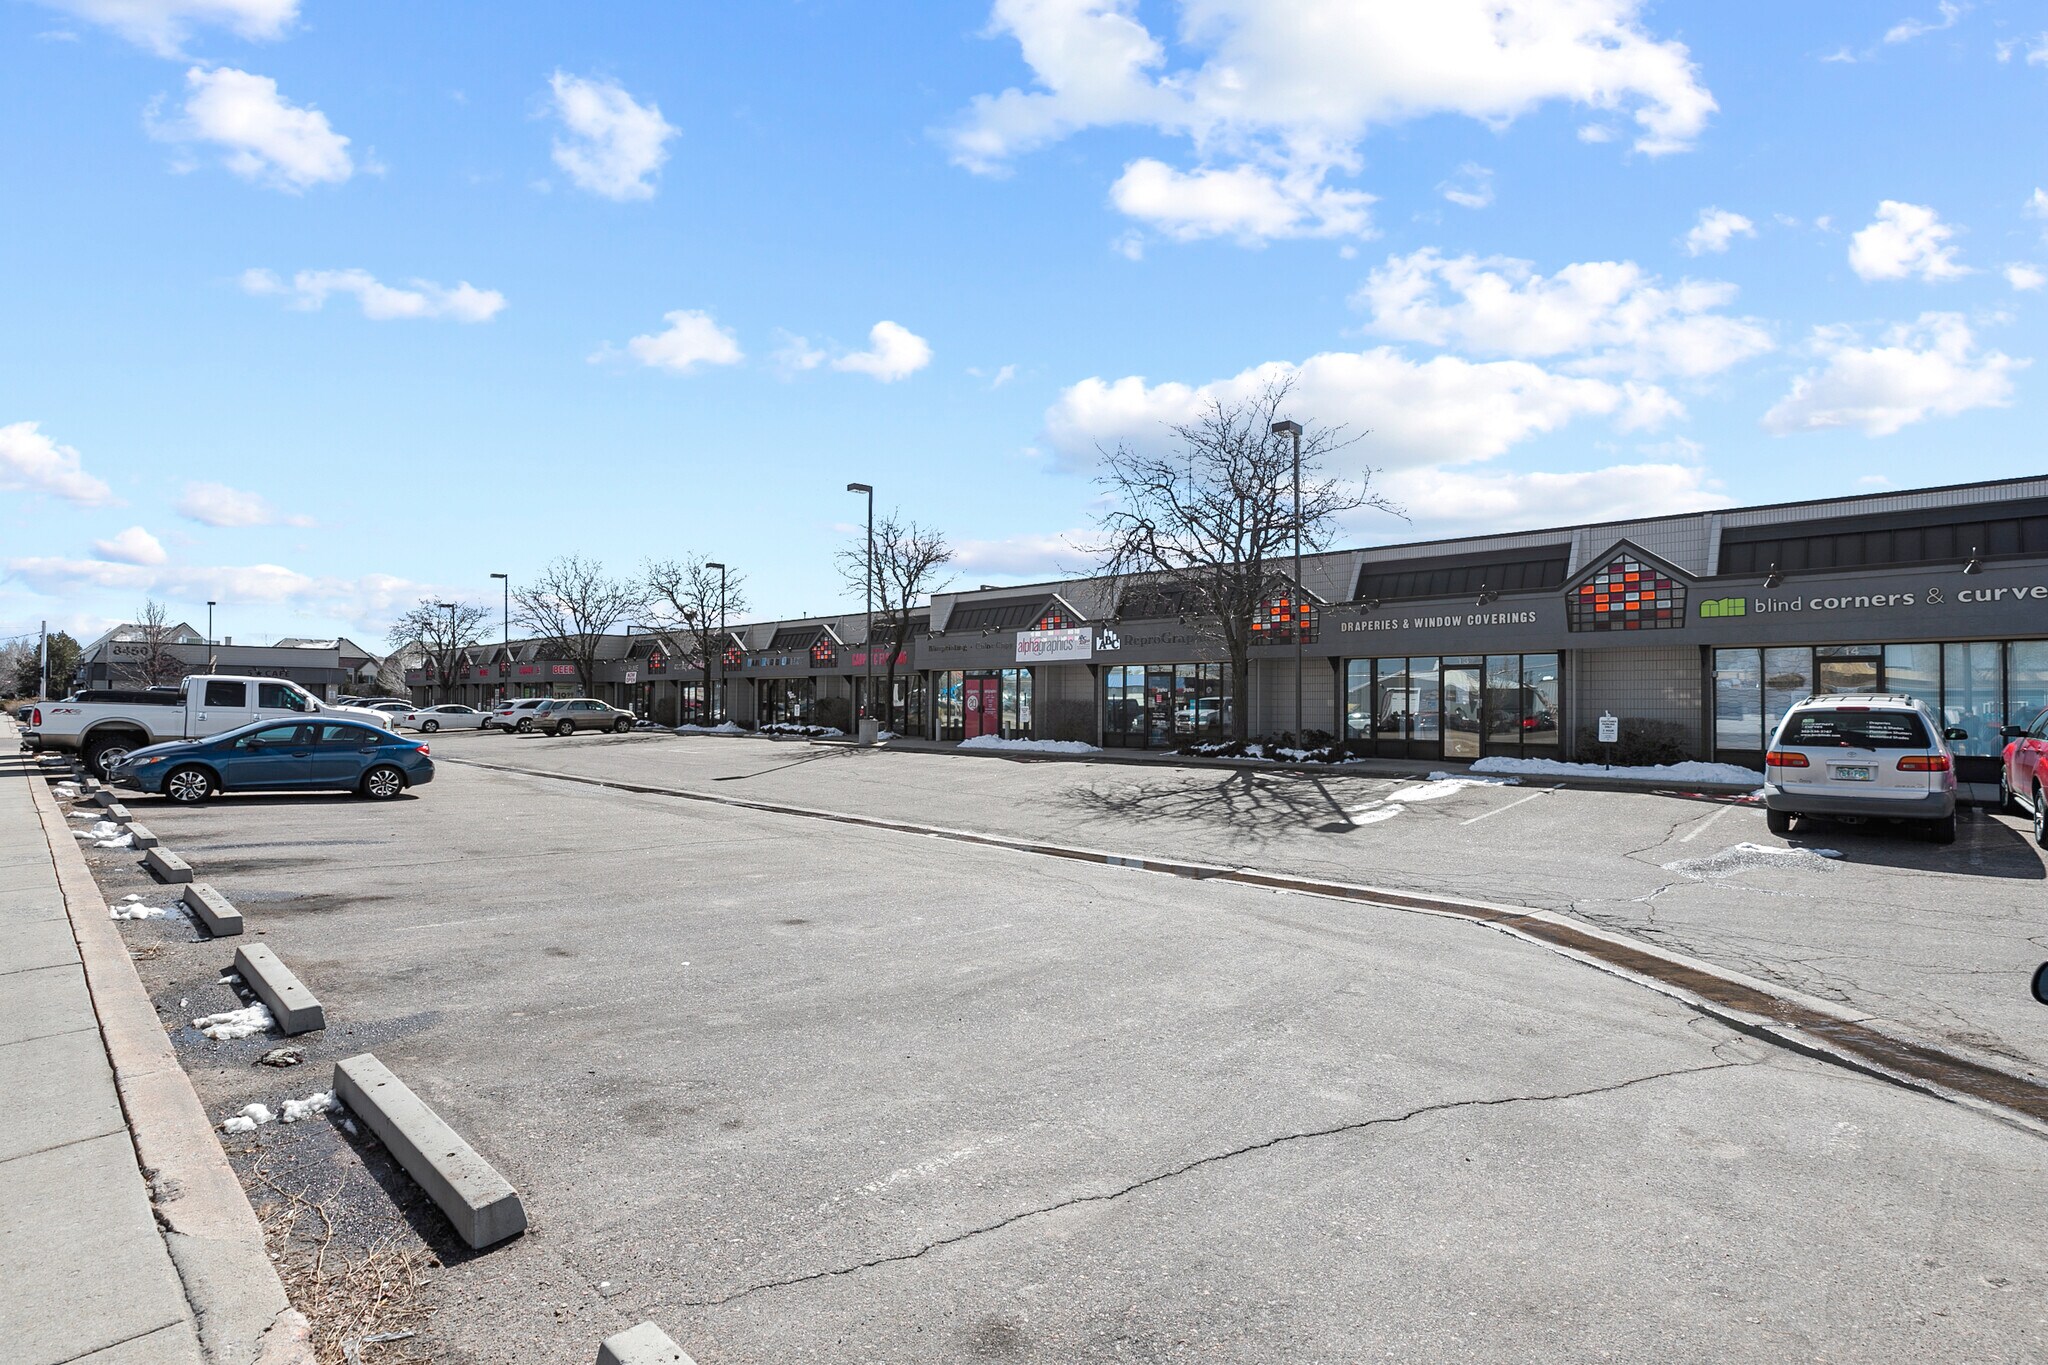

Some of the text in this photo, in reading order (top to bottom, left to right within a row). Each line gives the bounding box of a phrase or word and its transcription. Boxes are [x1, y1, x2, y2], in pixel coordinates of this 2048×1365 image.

[1755, 585, 2048, 613] blind corners & curve
[1341, 611, 1536, 632] DRAPERIES & WINDOW COVERINGS
[1018, 636, 1074, 656] alphagraphics
[1098, 635, 1120, 650] ABC
[1844, 646, 1859, 656] 14
[553, 665, 575, 674] BEER
